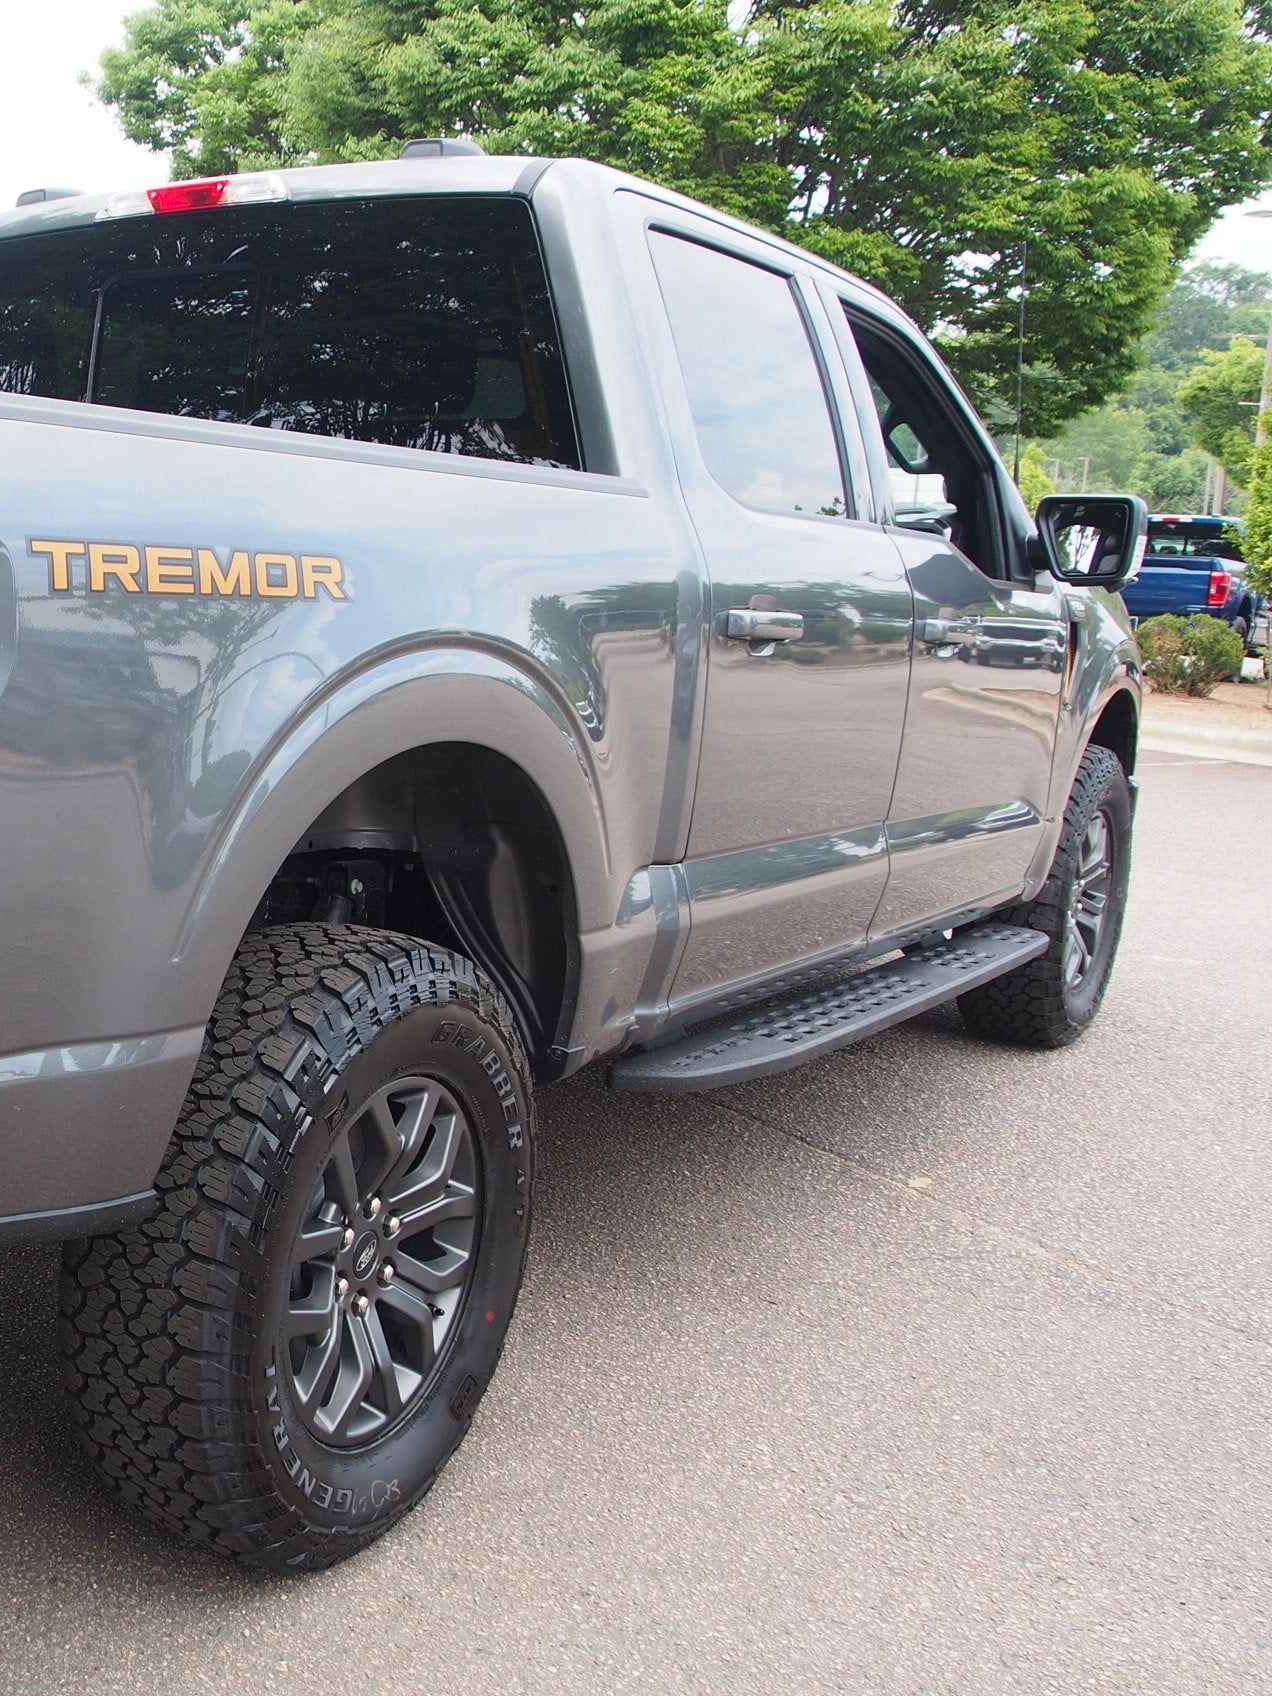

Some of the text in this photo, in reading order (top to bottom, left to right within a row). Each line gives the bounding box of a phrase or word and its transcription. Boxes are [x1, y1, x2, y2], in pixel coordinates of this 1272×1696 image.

[27, 536, 350, 601] TREMOR
[430, 1020, 524, 1149] GRABBER
[264, 1344, 354, 1514] GENERAL
